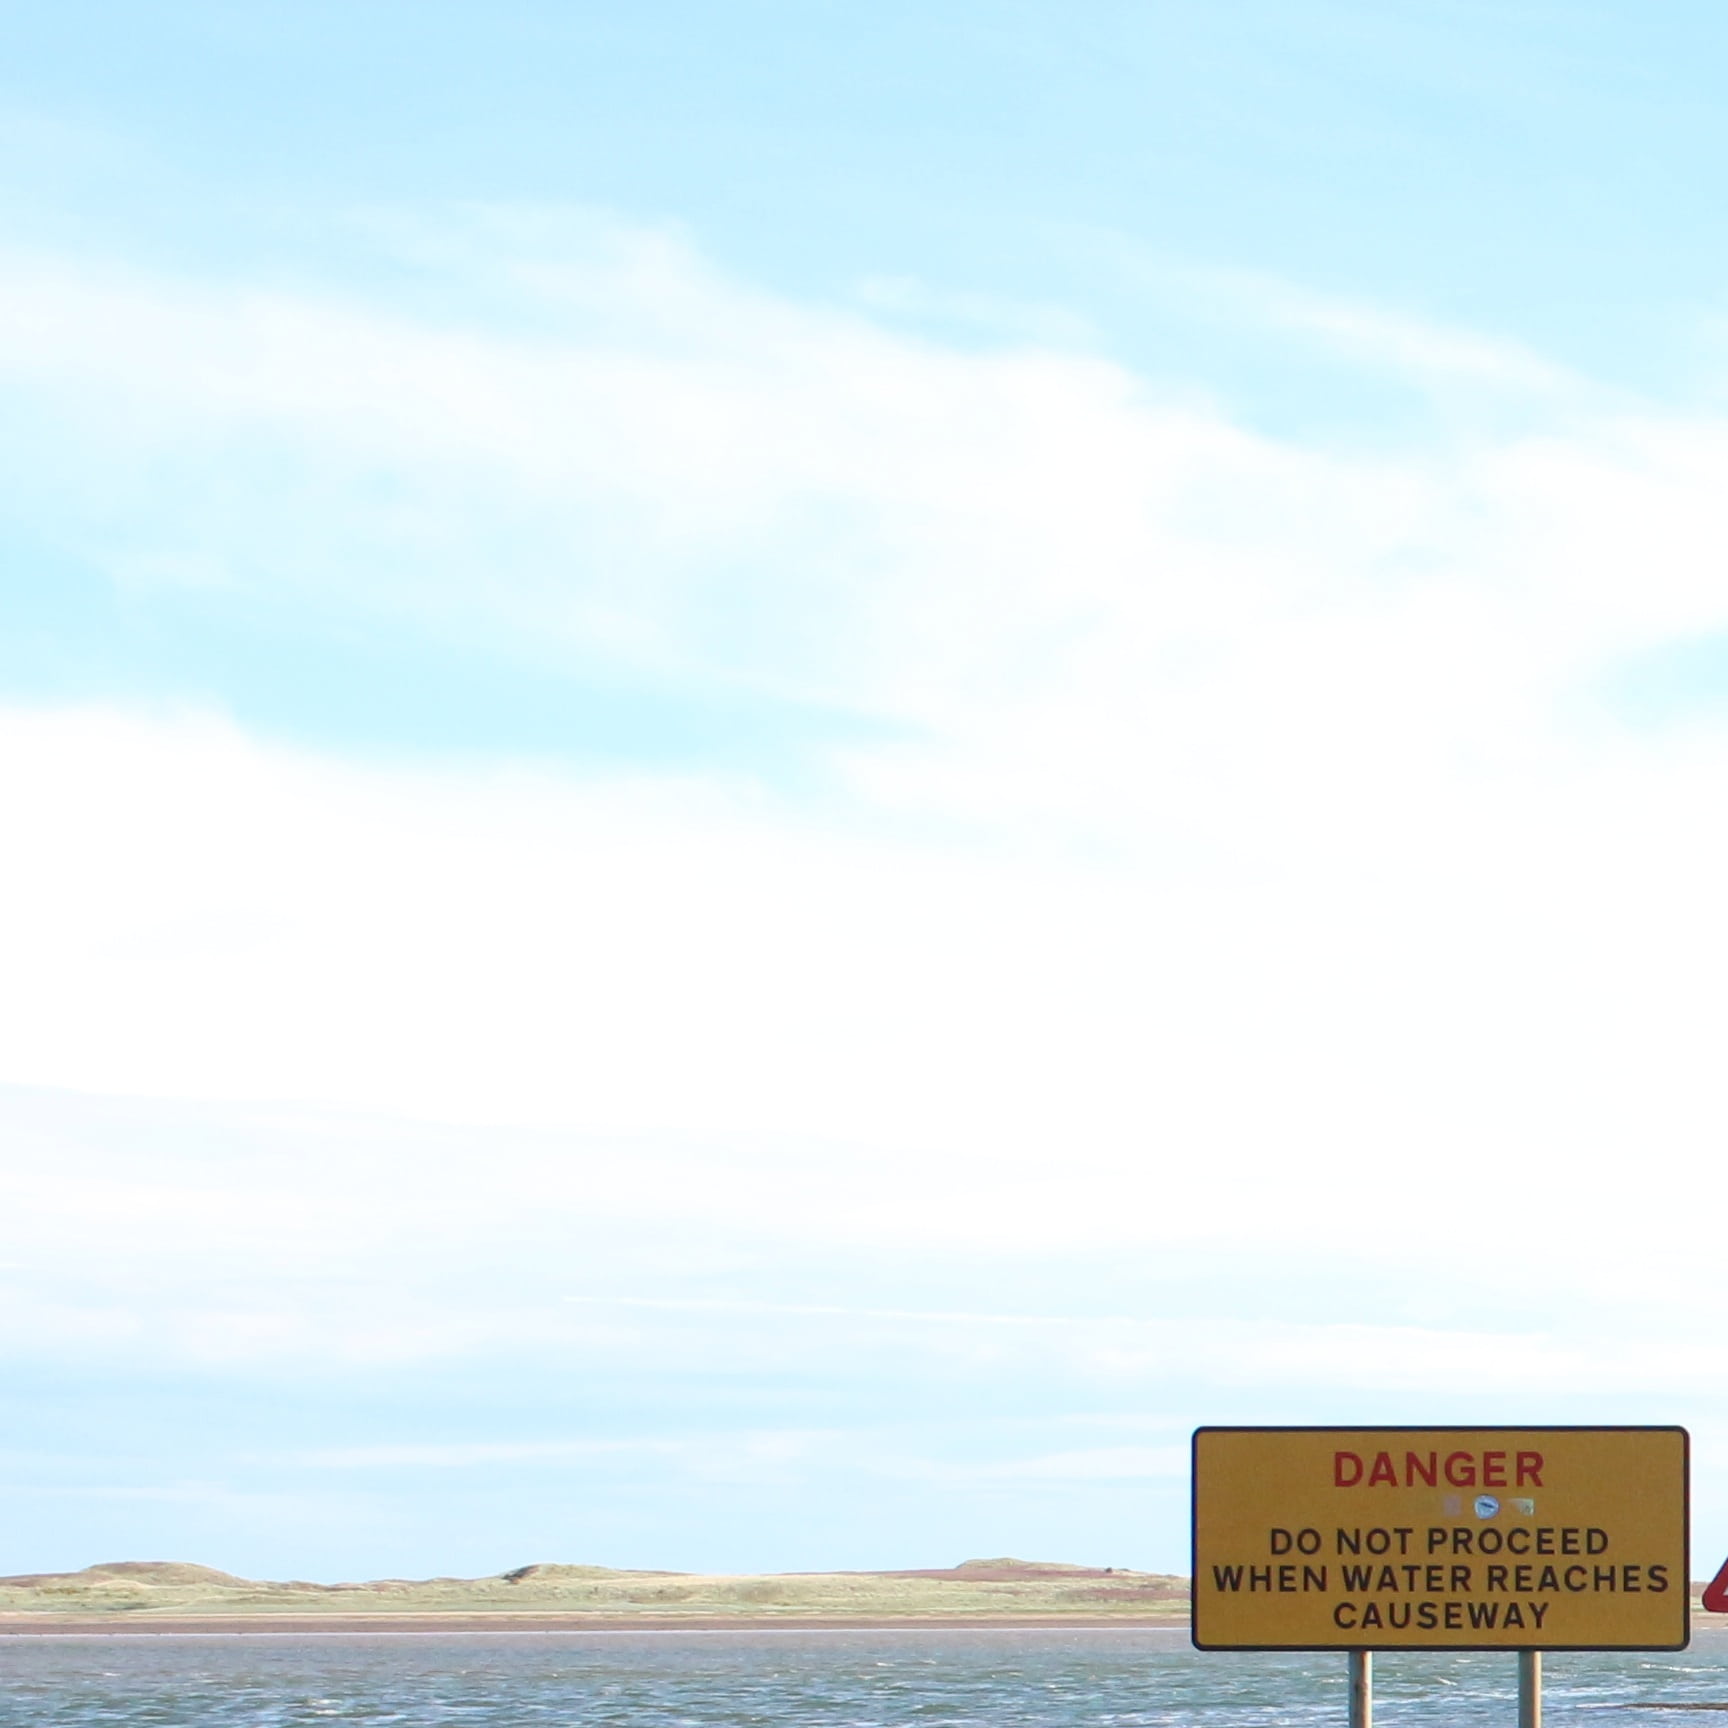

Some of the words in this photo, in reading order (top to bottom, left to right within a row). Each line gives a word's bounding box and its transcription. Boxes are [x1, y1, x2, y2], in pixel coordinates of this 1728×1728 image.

[1333, 1450, 1545, 1488] DANGER
[1267, 1526, 1323, 1557] DO
[1335, 1526, 1413, 1557] NOT
[1426, 1526, 1609, 1557] PROCEED
[1210, 1563, 1328, 1593] WHEN
[1340, 1563, 1473, 1593] WATER
[1486, 1563, 1669, 1594] REACHES
[1332, 1600, 1550, 1631] CAUSEWAY
